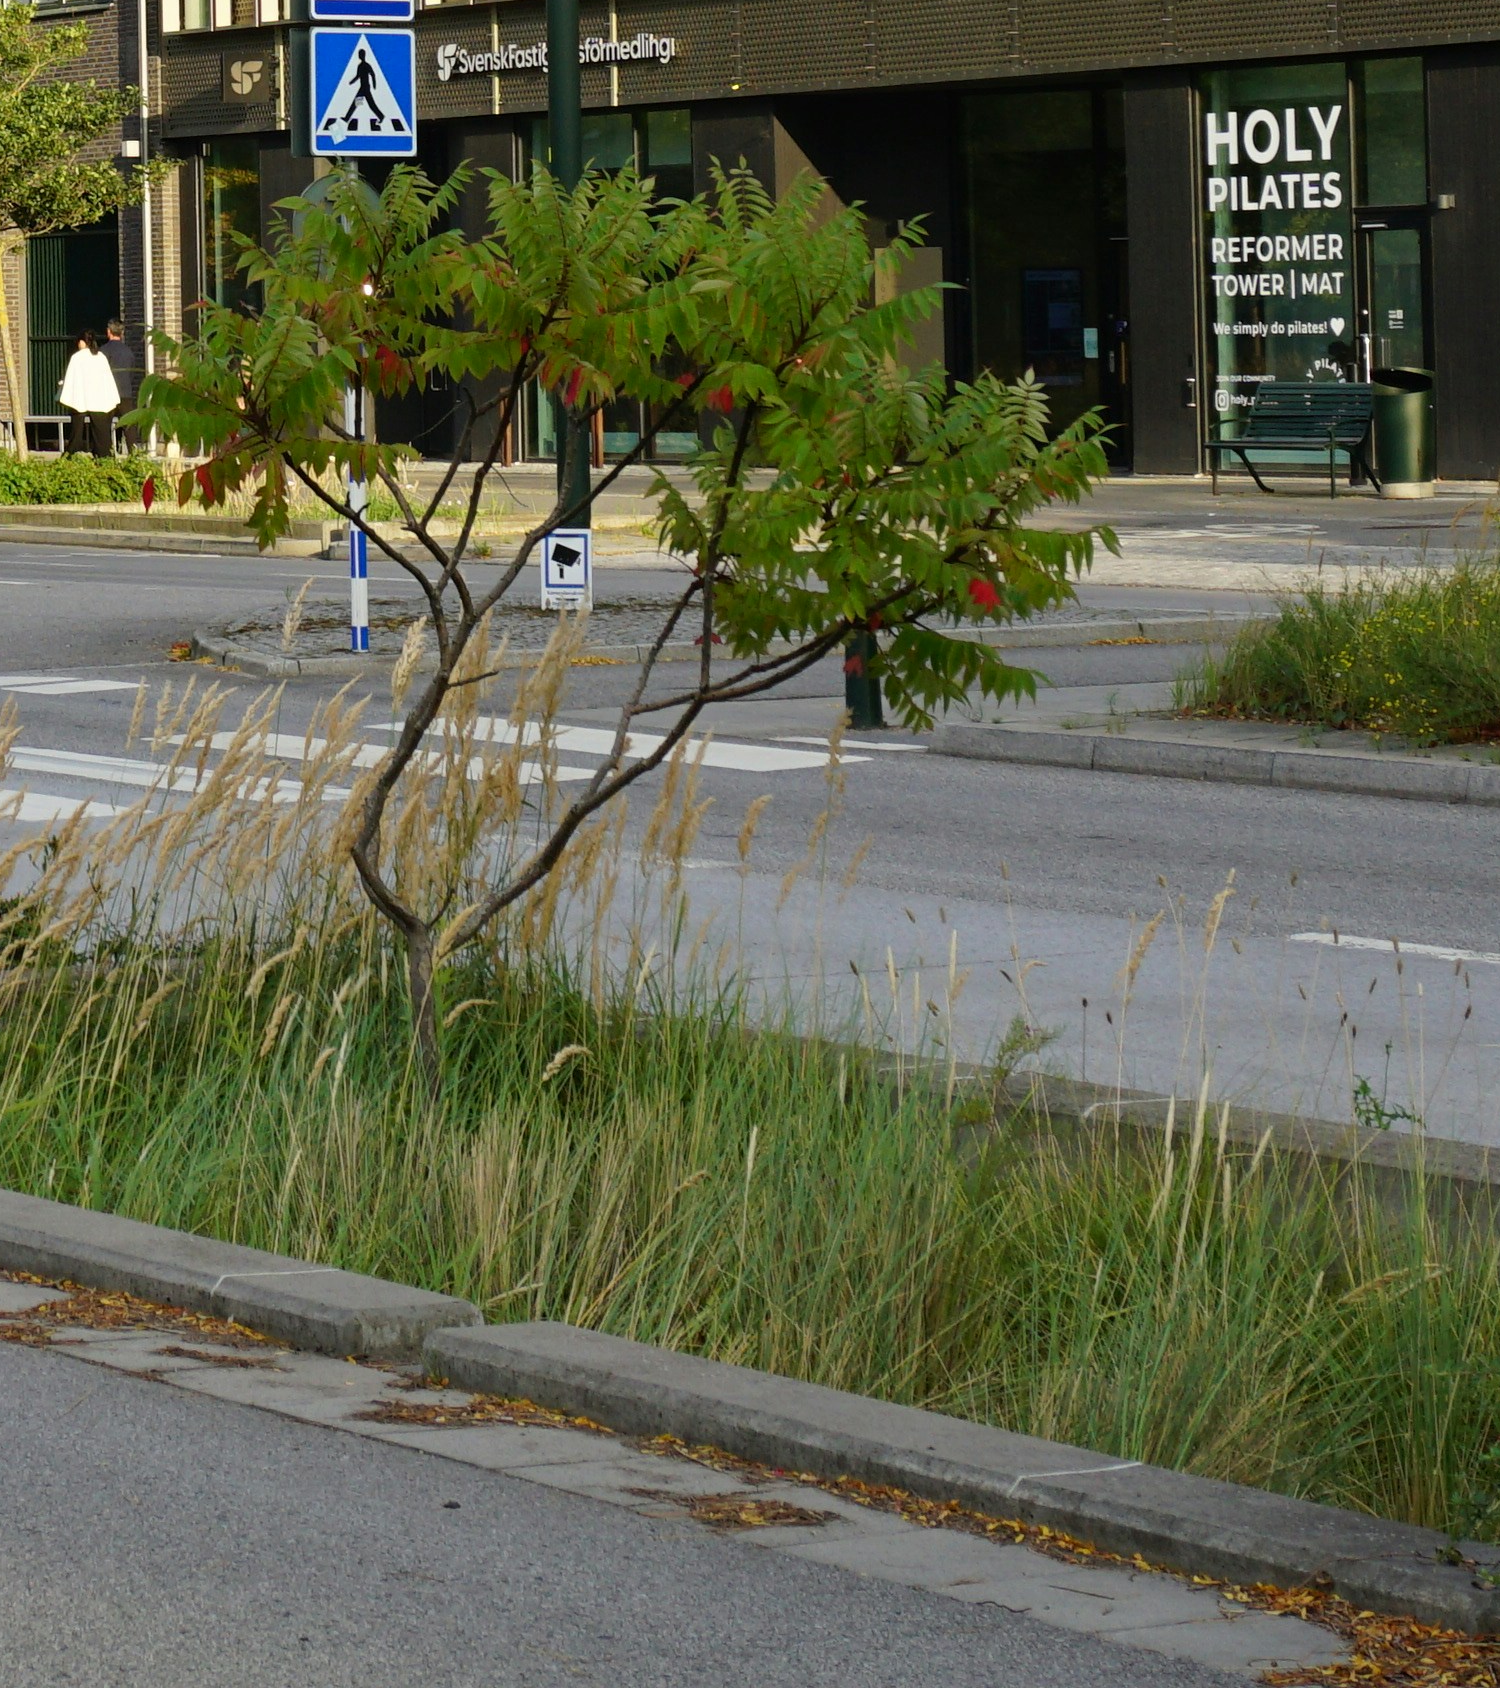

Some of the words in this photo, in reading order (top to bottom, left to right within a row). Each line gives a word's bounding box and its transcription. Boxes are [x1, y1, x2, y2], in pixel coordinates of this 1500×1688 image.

[1207, 105, 1342, 165] HOLY
[1208, 172, 1342, 212] PILATES
[1211, 233, 1343, 263] REFORMER
[1212, 274, 1284, 297] TOWER
[1302, 272, 1344, 295] MAT
[1213, 322, 1231, 335] We
[1233, 321, 1268, 337] simply
[1271, 320, 1285, 334] do
[1287, 320, 1328, 337] pilates!
